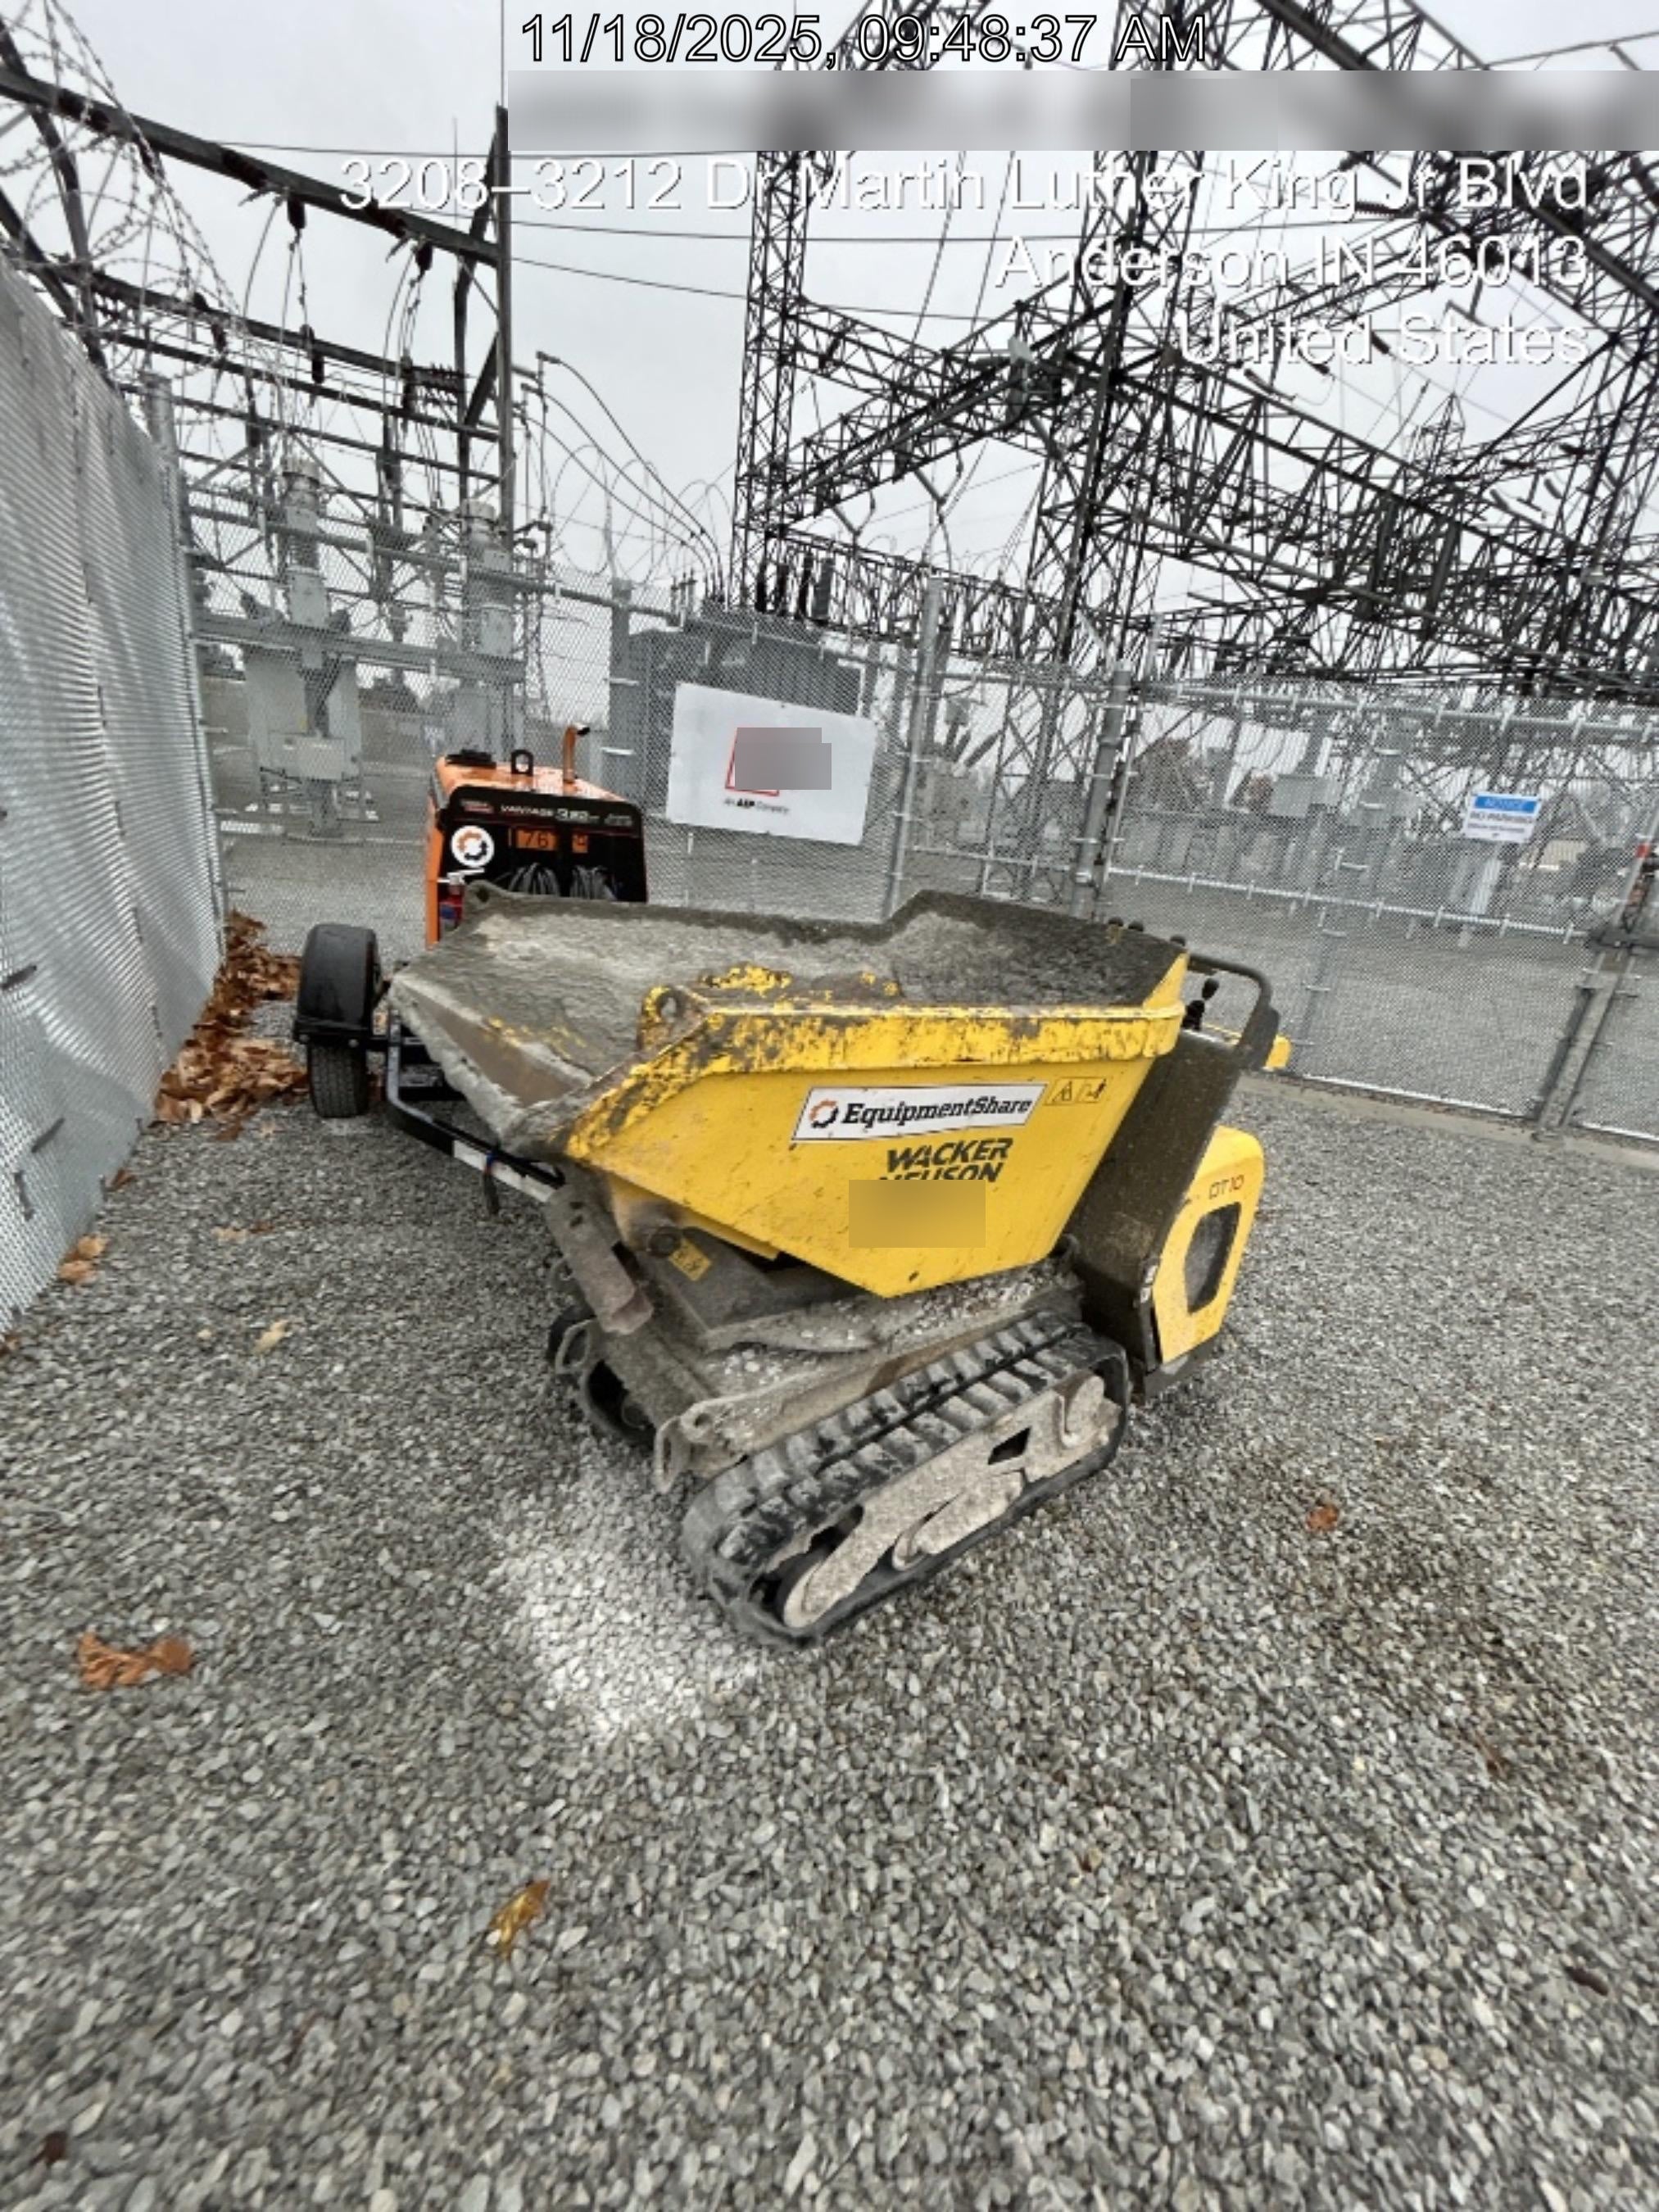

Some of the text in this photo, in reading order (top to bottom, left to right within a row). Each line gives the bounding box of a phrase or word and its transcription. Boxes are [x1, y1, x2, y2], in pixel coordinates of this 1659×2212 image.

[841, 1096, 1032, 1128] EquipmentShare
[887, 1138, 1013, 1173] WACKER
[1208, 1174, 1244, 1199] DT10
